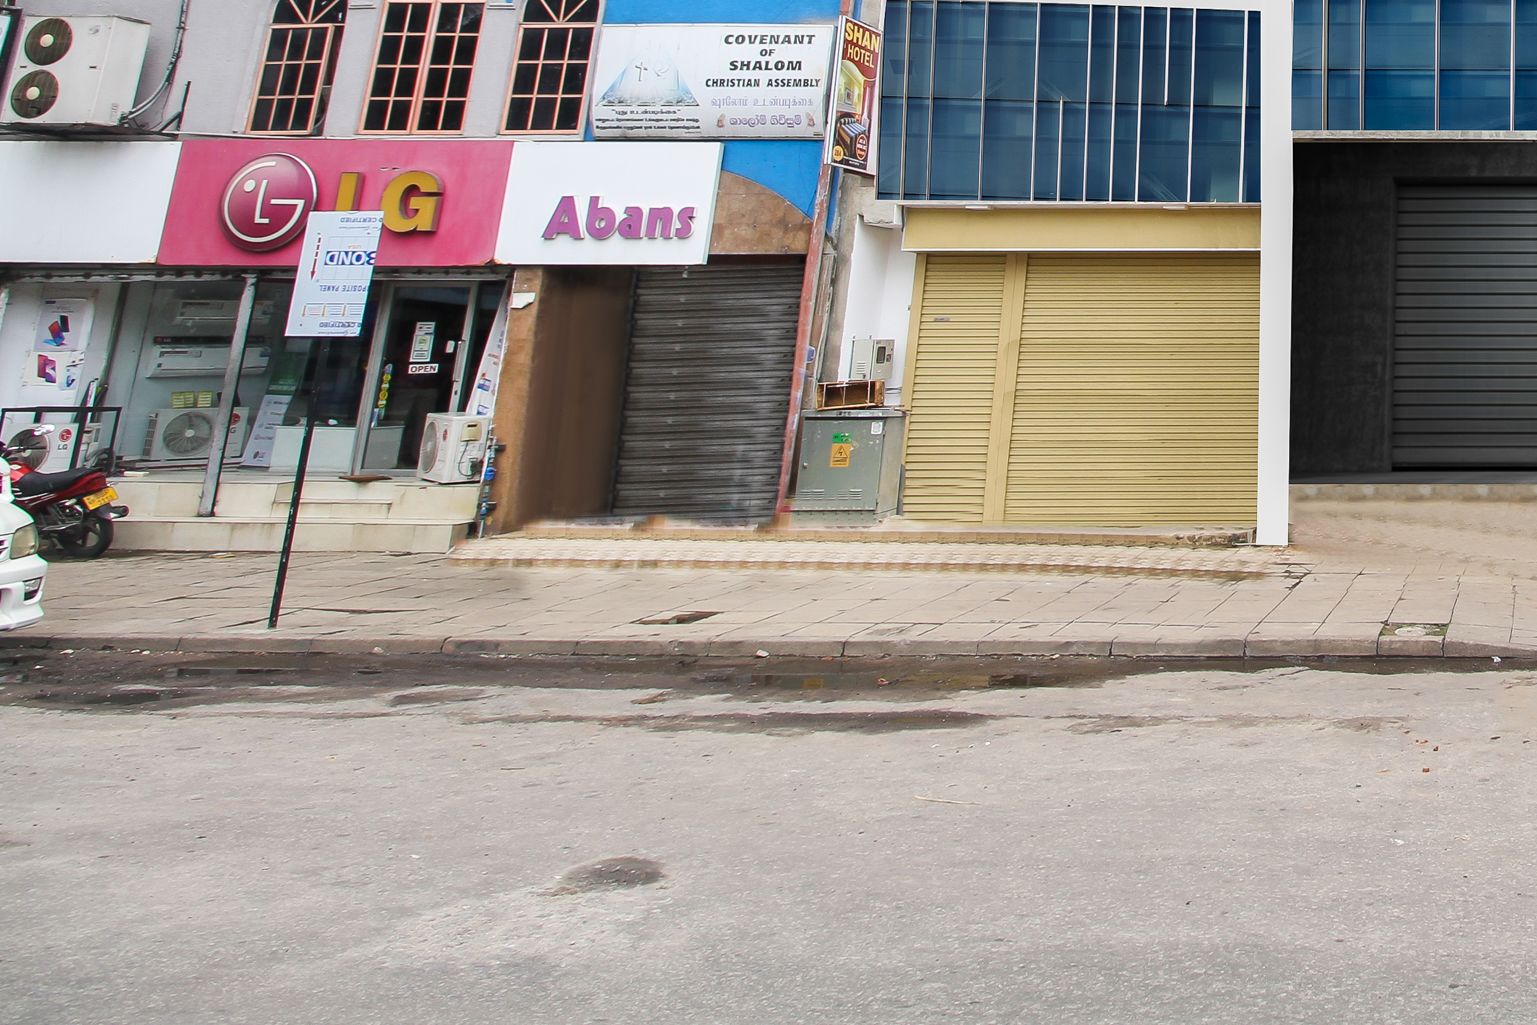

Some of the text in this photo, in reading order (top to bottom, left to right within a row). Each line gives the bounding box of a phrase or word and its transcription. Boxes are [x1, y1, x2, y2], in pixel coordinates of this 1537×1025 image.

[723, 34, 816, 46] COVENANT
[845, 22, 880, 53] SHAN
[759, 48, 776, 57] OF
[847, 44, 875, 69] HOTEL
[728, 60, 802, 71] SHALOM
[705, 78, 821, 88] CHRISTIAN ASSEMBLY
[542, 194, 698, 241] Abans
[410, 364, 437, 373] OPEN
[57, 443, 69, 451] LG
